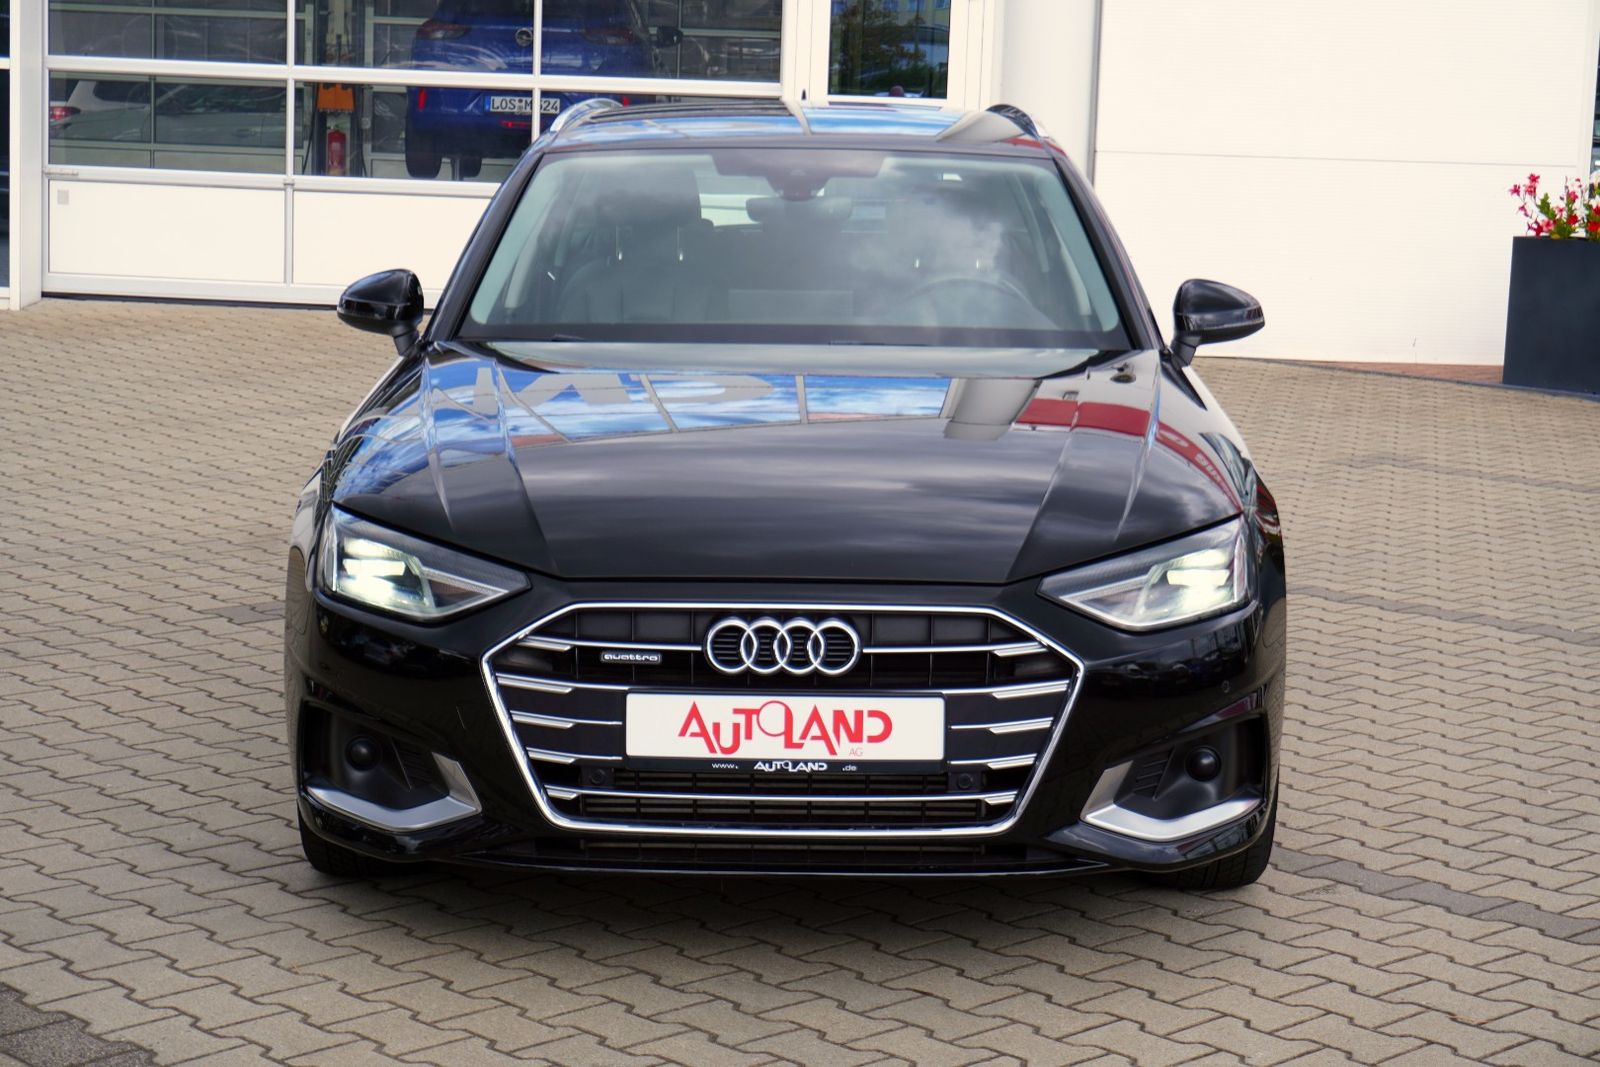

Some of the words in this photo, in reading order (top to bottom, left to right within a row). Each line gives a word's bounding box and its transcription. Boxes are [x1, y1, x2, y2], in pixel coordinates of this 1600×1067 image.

[603, 653, 659, 662] quattro
[678, 700, 893, 756] AUTOLAND
[848, 748, 864, 757] AG
